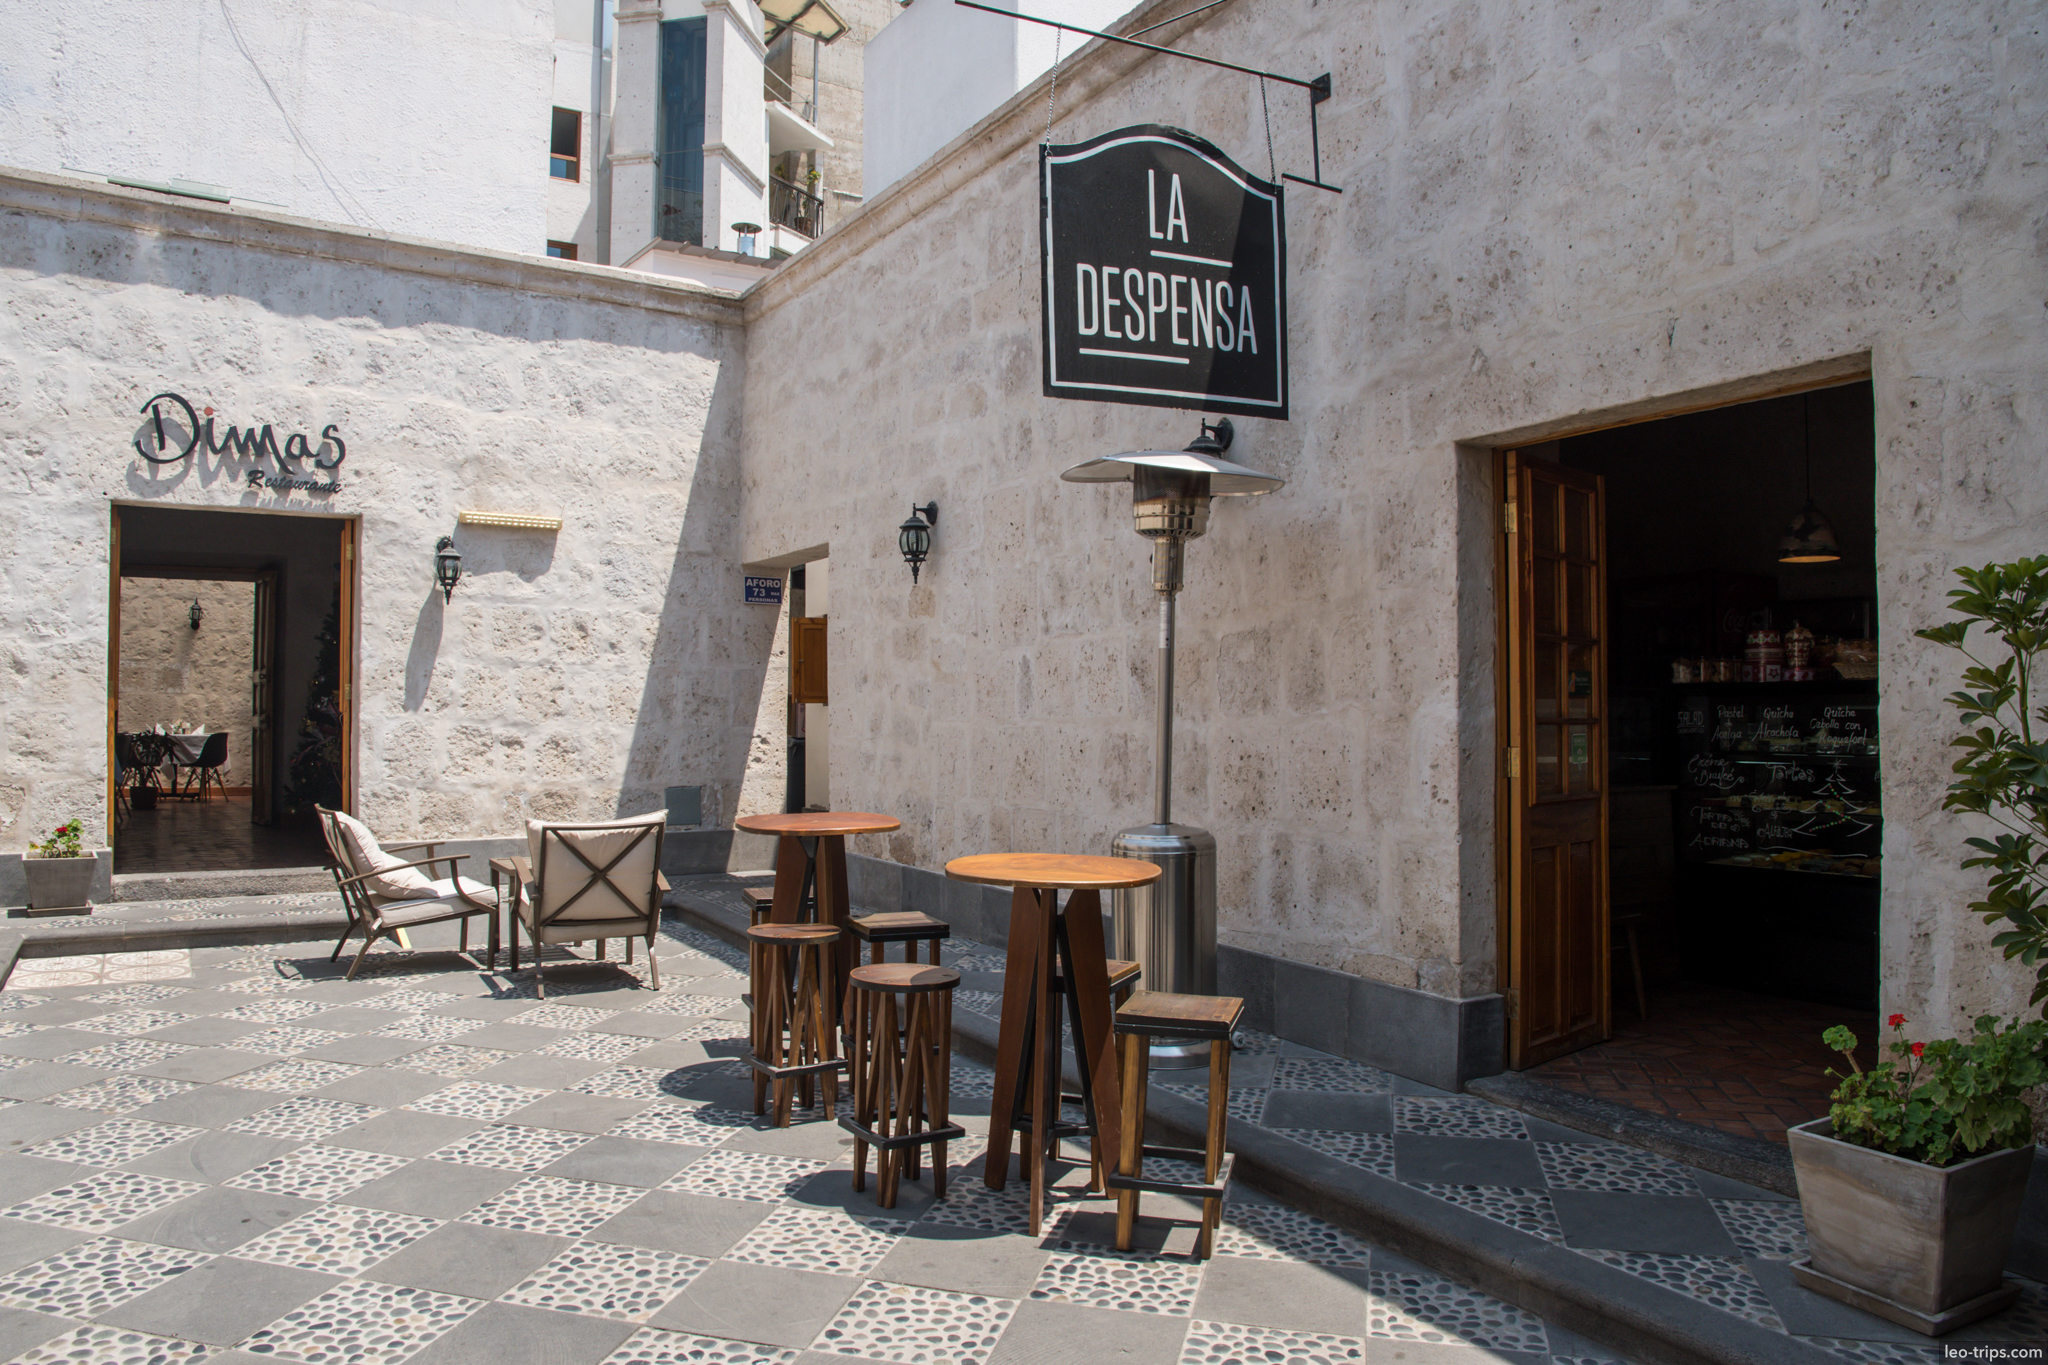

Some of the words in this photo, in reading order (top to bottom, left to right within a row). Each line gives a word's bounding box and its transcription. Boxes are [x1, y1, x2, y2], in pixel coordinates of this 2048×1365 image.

[1148, 169, 1189, 244] LA
[1076, 262, 1258, 355] DESPENSA
[134, 392, 346, 475] Dimas
[247, 469, 343, 494] Restaurante
[746, 578, 780, 588] AFORO
[752, 588, 766, 596] 73
[1677, 710, 1704, 725] SALAD
[1717, 704, 1744, 718] Pastel
[1763, 704, 1795, 720] Quiche
[1823, 705, 1856, 719] Quiche
[1724, 718, 1733, 727] de
[1809, 718, 1840, 730] Cebolla
[1844, 723, 1862, 731] con
[1711, 725, 1743, 746] Acelga
[1751, 721, 1799, 747] Alcachofa
[1818, 728, 1867, 752] Roquefort
[1766, 760, 1816, 784] Tartas
